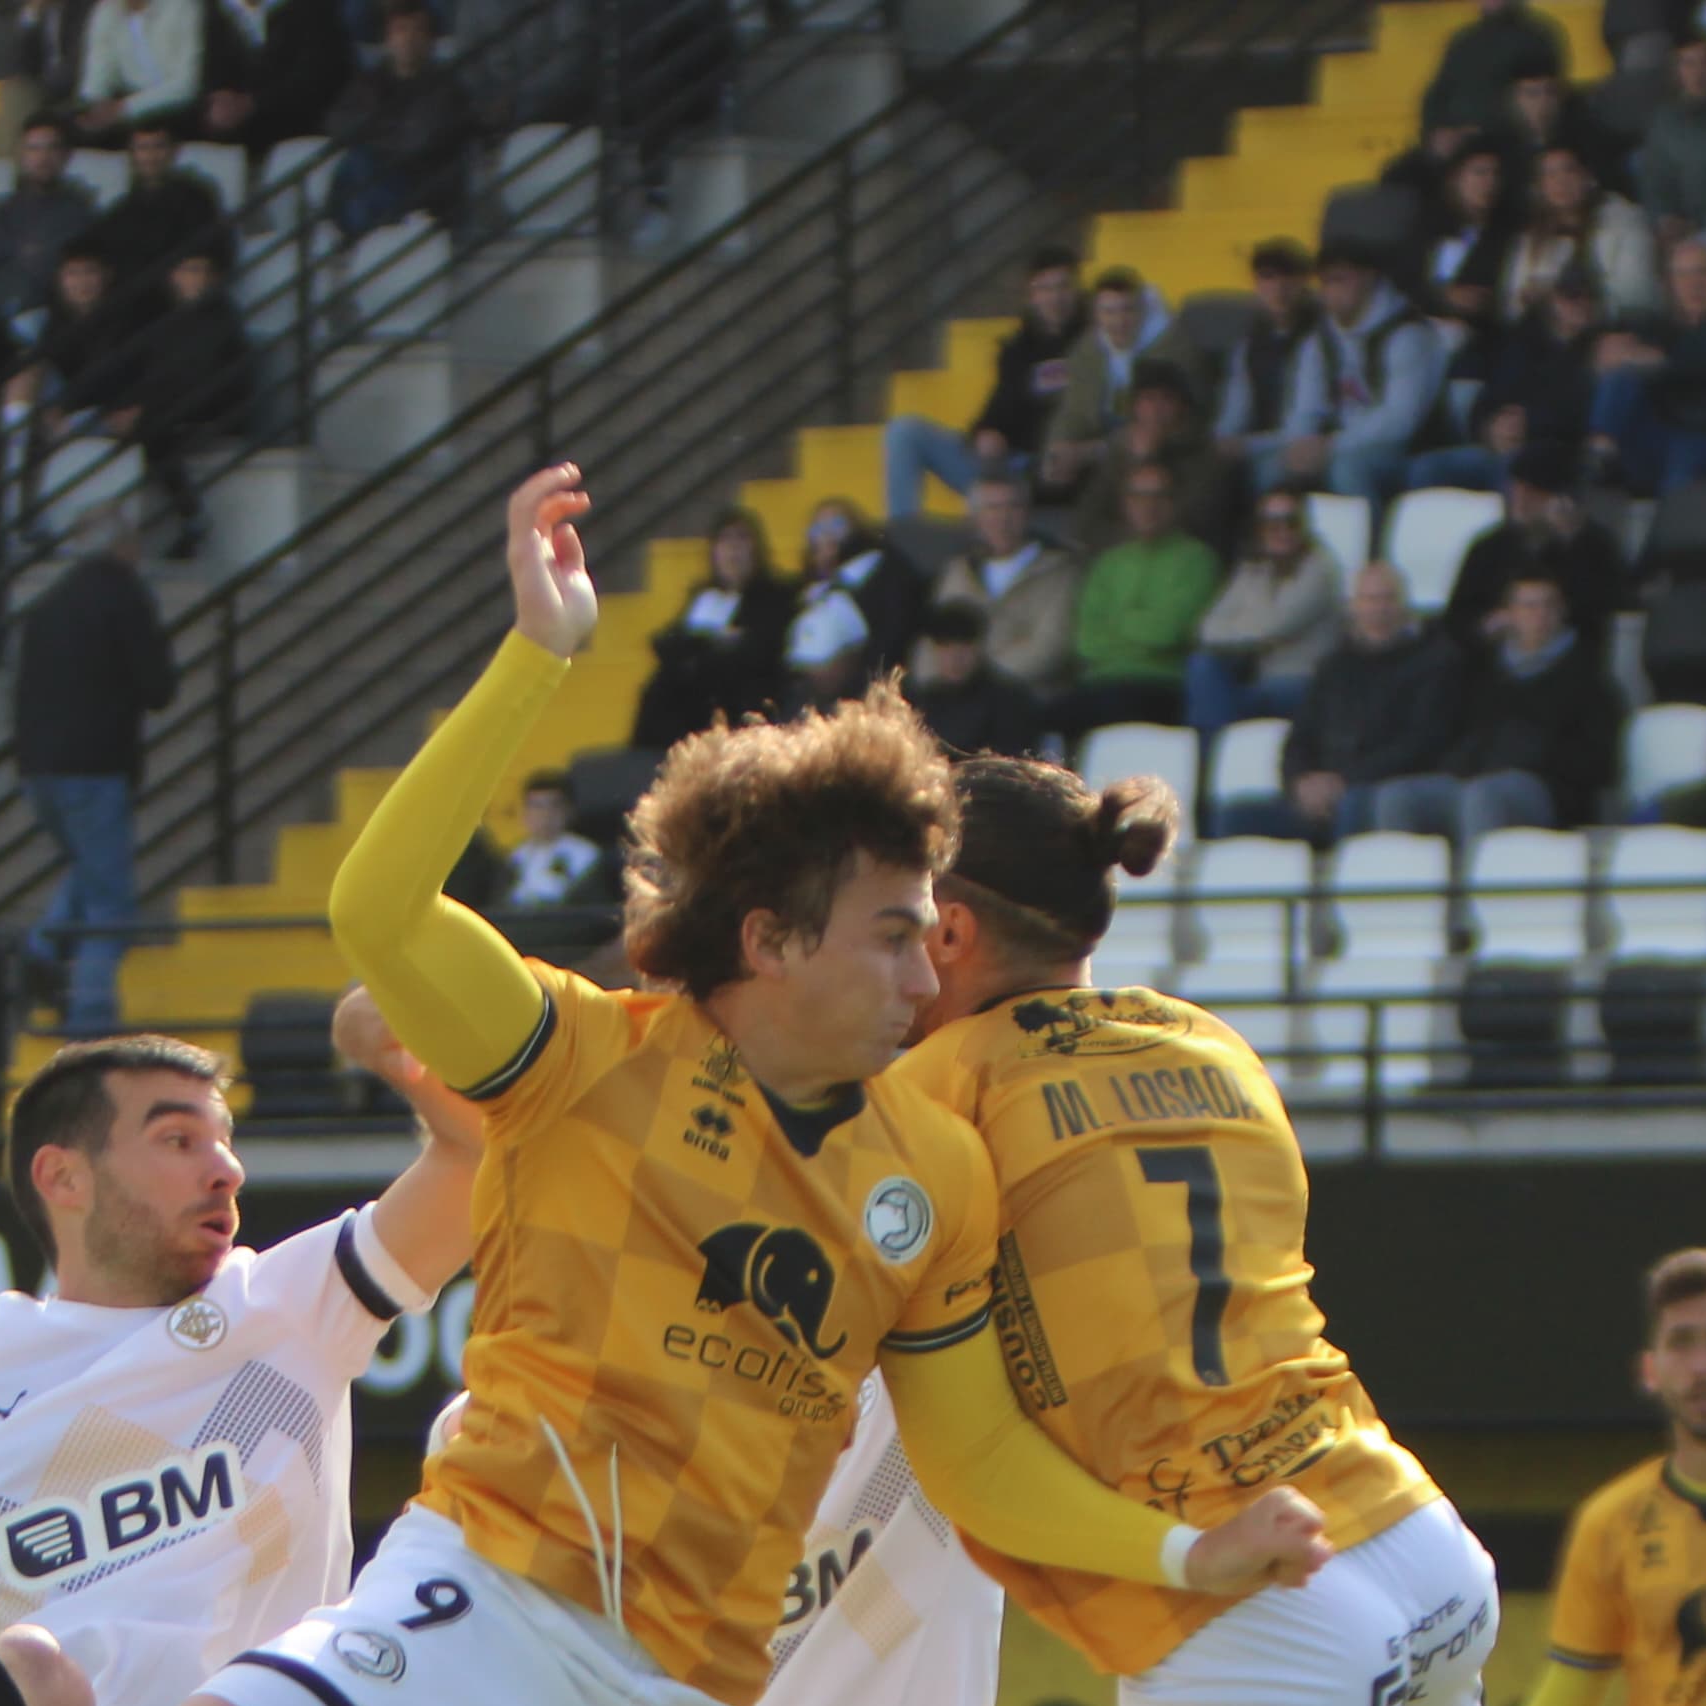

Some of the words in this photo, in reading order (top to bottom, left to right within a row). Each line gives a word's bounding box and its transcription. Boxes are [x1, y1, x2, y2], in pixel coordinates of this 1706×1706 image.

[1041, 1078, 1114, 1141] M.
[1108, 1063, 1265, 1122] LOSADA
[1135, 1146, 1231, 1387] 7
[100, 1450, 236, 1552] BM
[396, 1578, 474, 1632] 9
